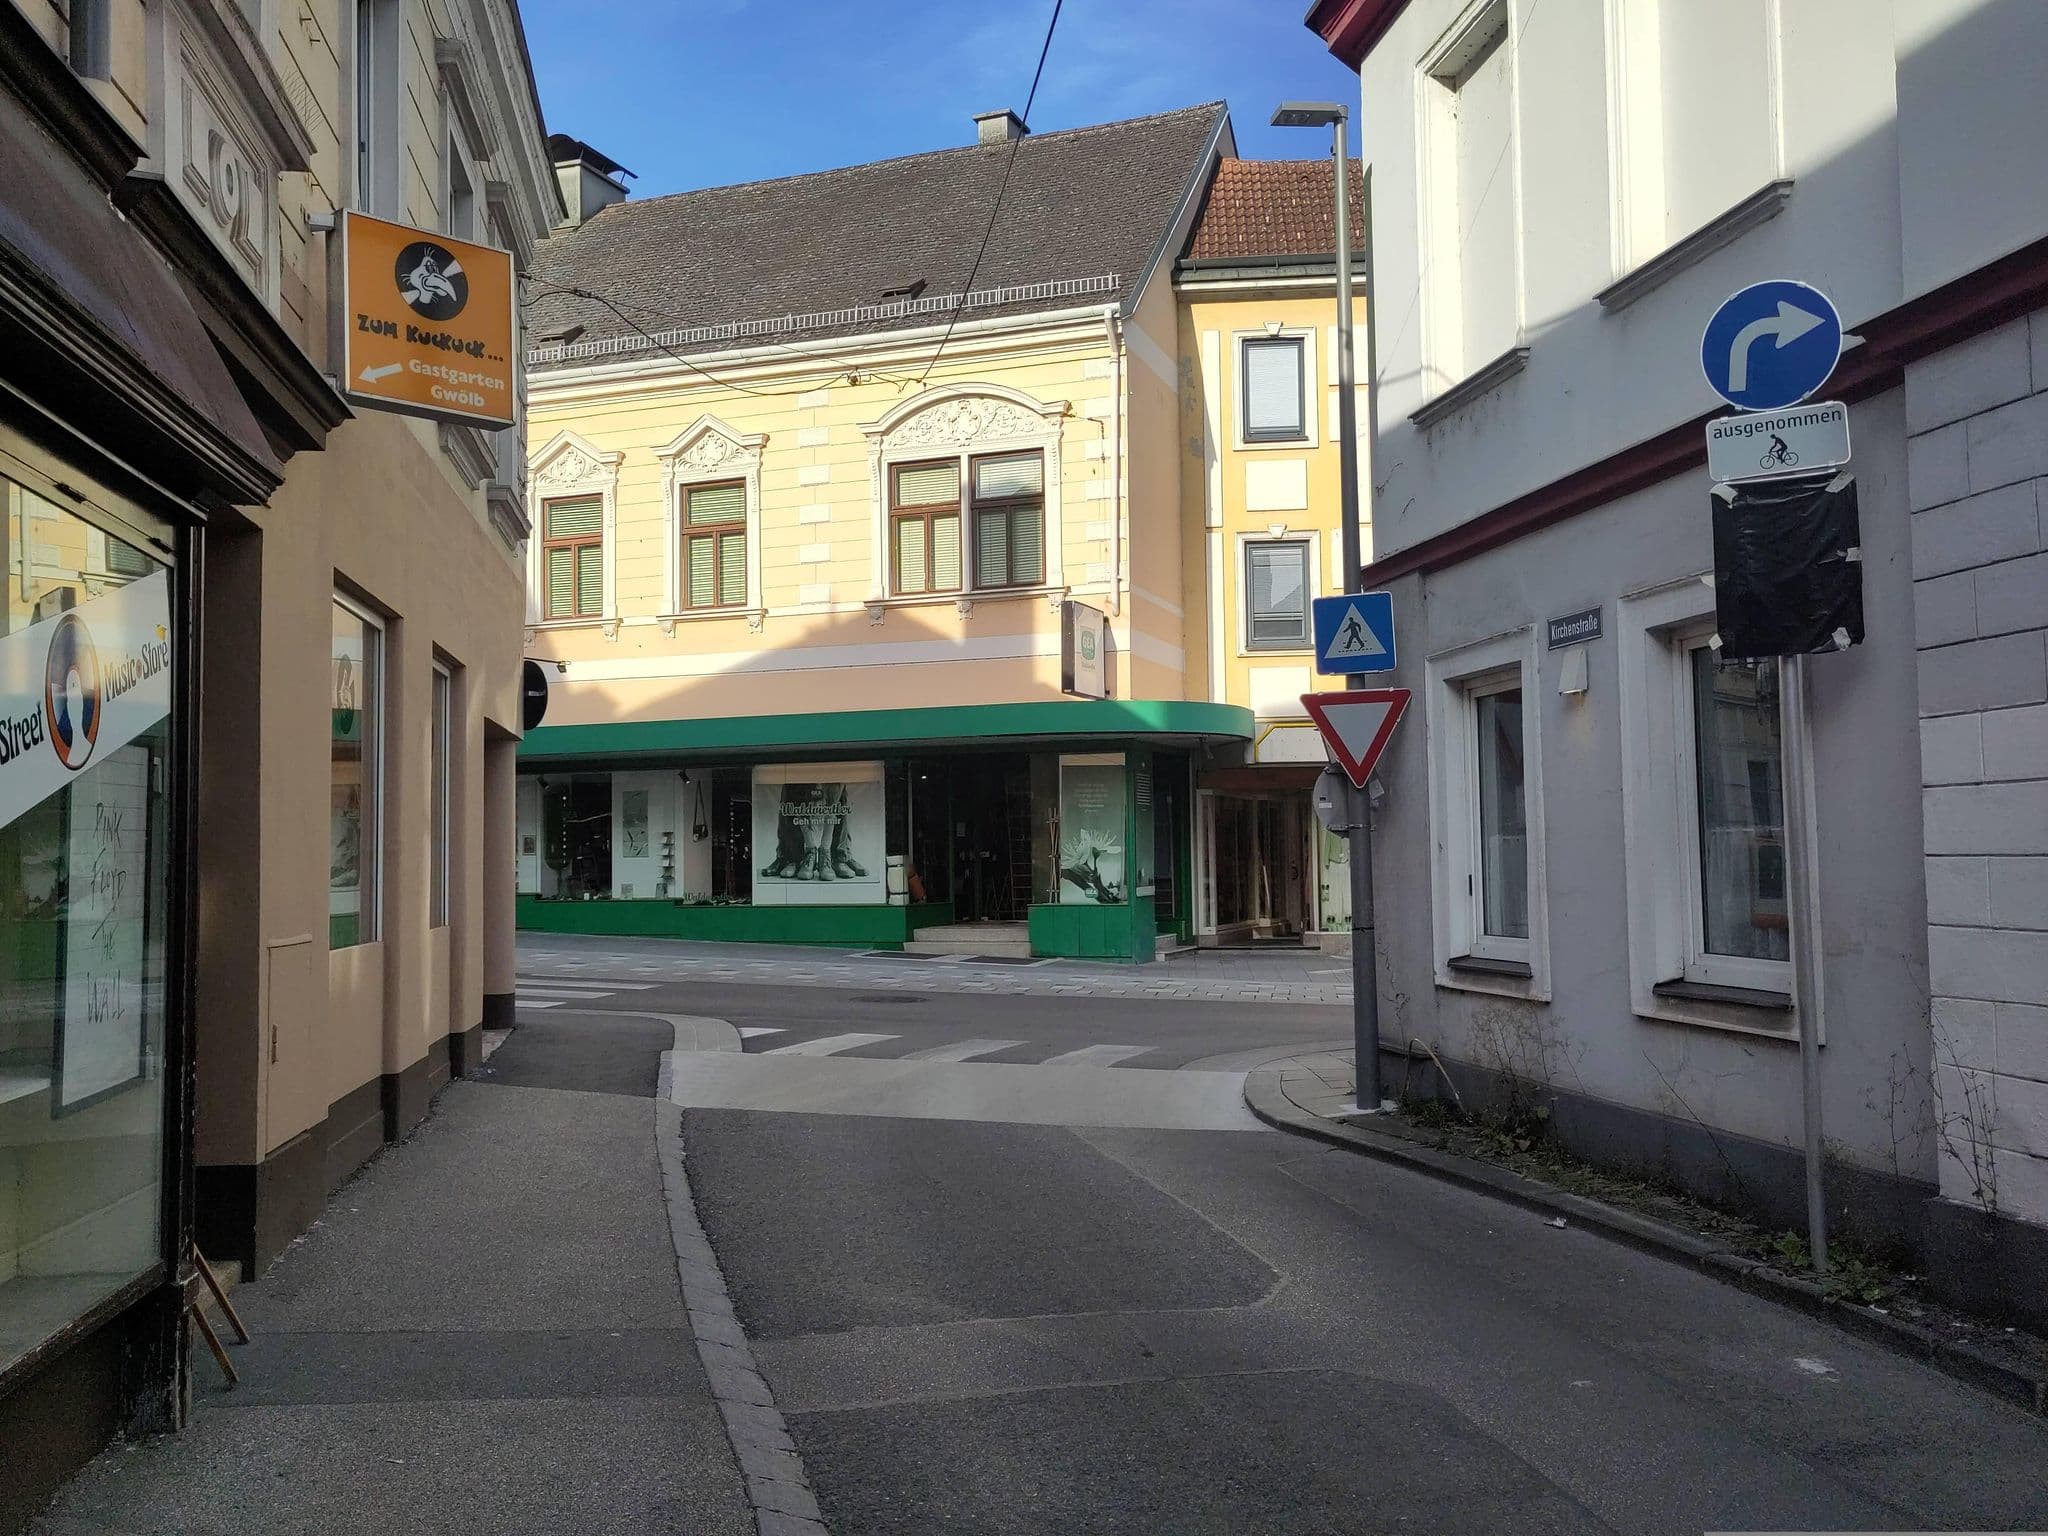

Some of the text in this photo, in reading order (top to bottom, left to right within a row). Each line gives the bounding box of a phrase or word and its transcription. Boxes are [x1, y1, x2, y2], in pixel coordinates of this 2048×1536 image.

[408, 359, 505, 390] Gastgarten
[430, 385, 485, 407] Gwölb
[1713, 410, 1842, 438] ausgenommen
[1551, 614, 1598, 640] Kirchenstraße
[0, 702, 44, 765] Street
[93, 801, 122, 857] PINK
[90, 848, 126, 911] FLOYD
[87, 969, 125, 1024] WALL
